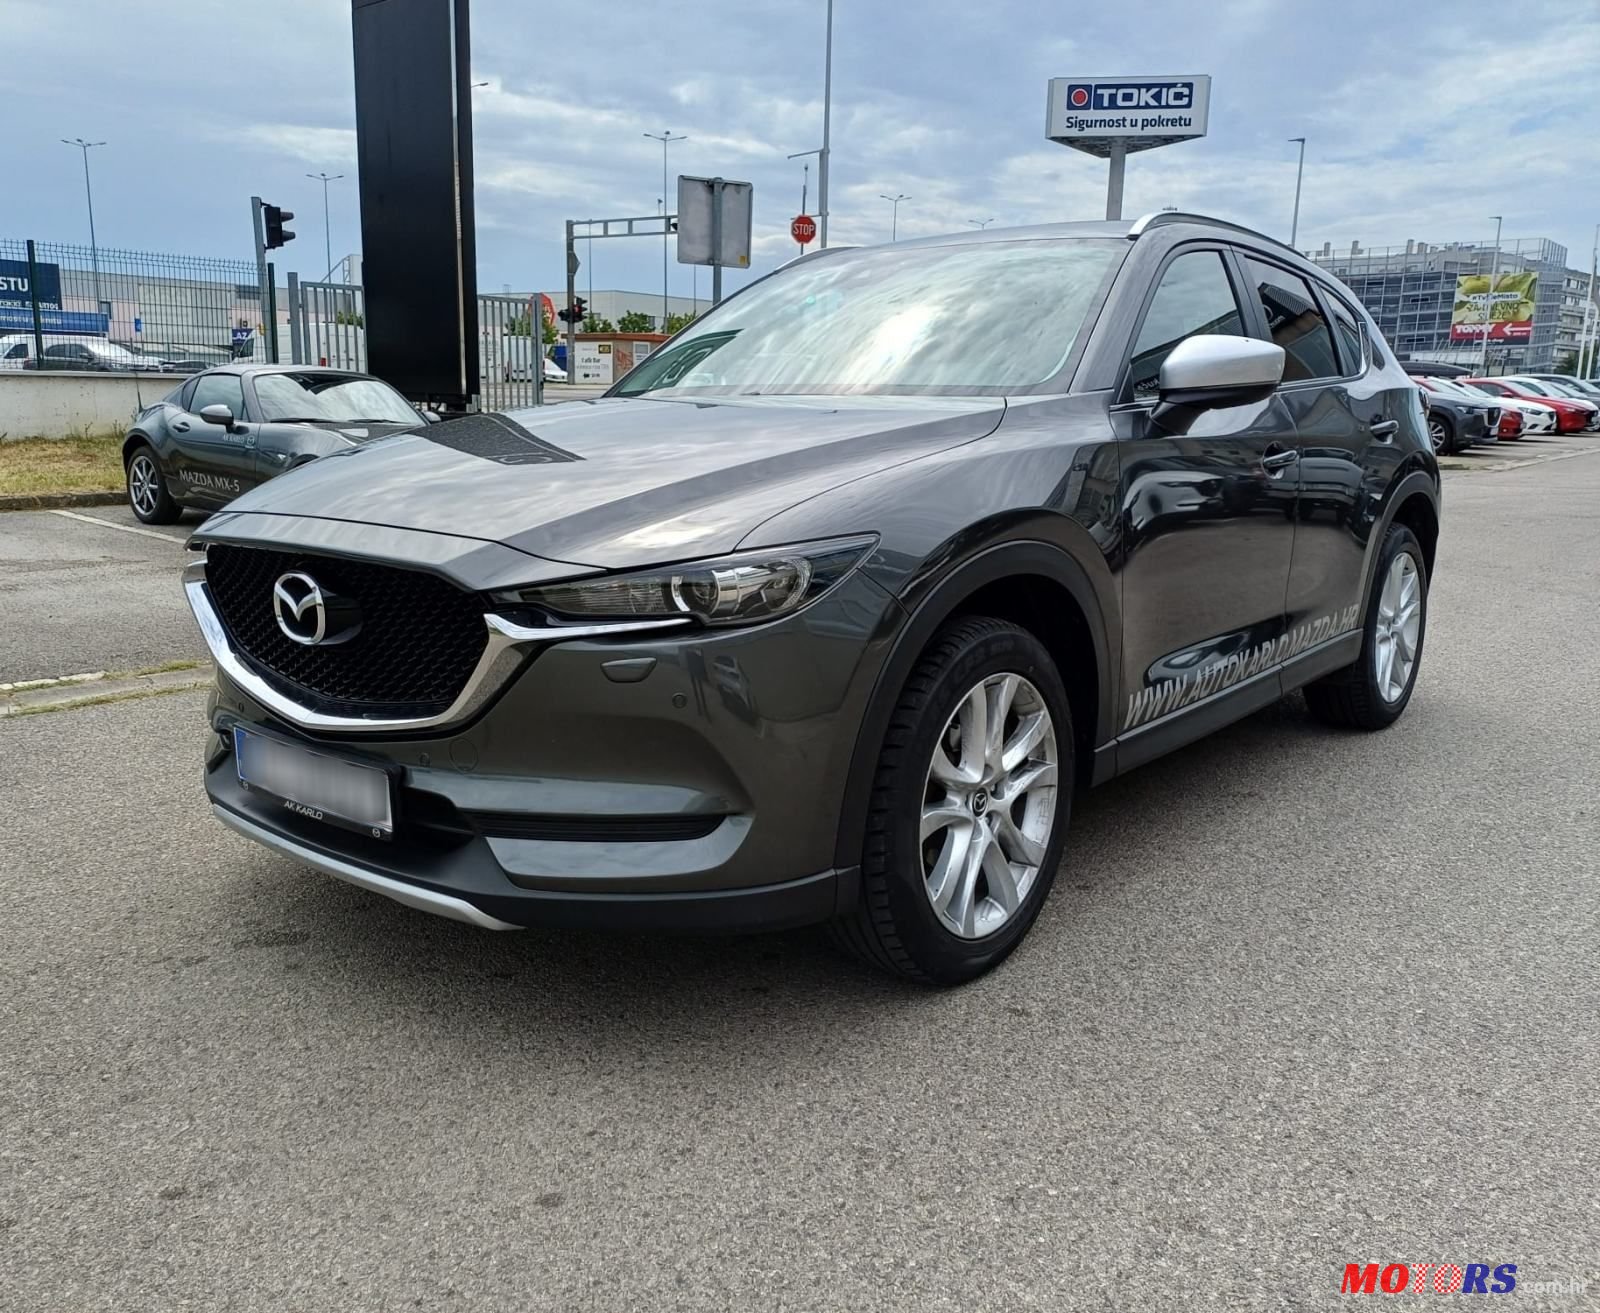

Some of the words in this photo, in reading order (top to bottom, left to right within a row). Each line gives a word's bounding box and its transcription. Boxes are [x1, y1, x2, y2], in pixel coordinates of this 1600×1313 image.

[1096, 83, 1190, 107] TOKIĆ
[1066, 116, 1127, 132] Sigurnost
[1130, 118, 1138, 127] u
[1141, 115, 1191, 131] pokretu
[793, 224, 814, 236] STOP
[179, 469, 214, 488] MAZDA
[214, 475, 240, 492] MX-5
[283, 800, 296, 811] AK
[295, 803, 323, 820] KARLO
